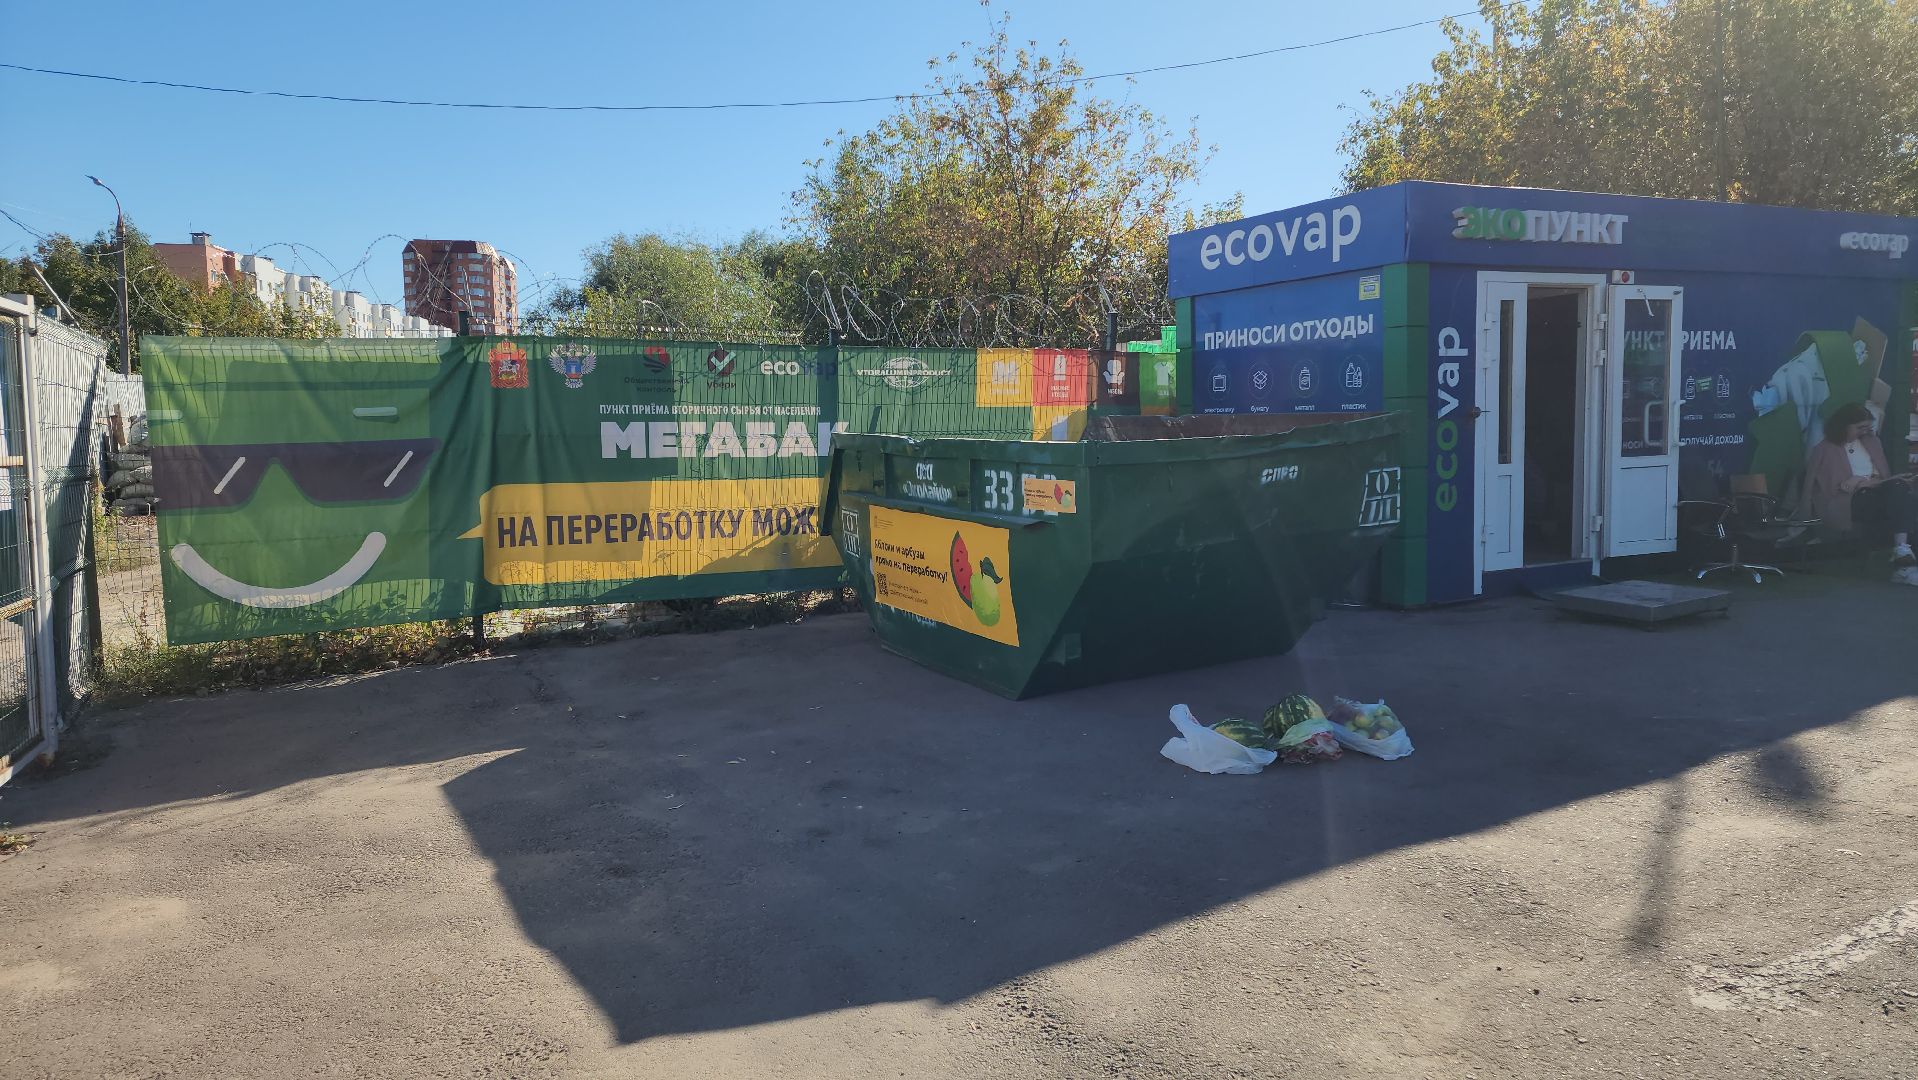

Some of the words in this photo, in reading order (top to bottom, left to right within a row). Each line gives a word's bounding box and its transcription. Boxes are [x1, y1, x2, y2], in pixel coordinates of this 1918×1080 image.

[1201, 204, 1362, 271] ecovap
[1453, 206, 1629, 244] ЭКОПУНКТ
[1841, 232, 1909, 259] ecovap
[1204, 324, 1286, 350] ПРИНОСИ
[1289, 314, 1374, 341] ОТХОДЫ
[1624, 331, 1665, 350] УНКТ
[1681, 331, 1737, 350] РИЕМА
[600, 404, 630, 415] ПУНКТ
[632, 403, 670, 414] ПРИЁМА
[671, 405, 729, 416] ВТОРИЧНОГО
[731, 406, 761, 416] СЫРЬЯ
[763, 407, 774, 416] ОТ
[774, 406, 822, 416] НАСЕЛЕНИЯ
[1435, 326, 1469, 512] ecovap
[600, 421, 850, 458] МЕГАБАК
[1715, 434, 1745, 446] ДОХОДЫ
[984, 470, 1014, 511] 33
[497, 515, 538, 548] НА
[546, 509, 745, 546] ПЕРЕРАБОТКУ
[752, 506, 816, 537] МОЖ
